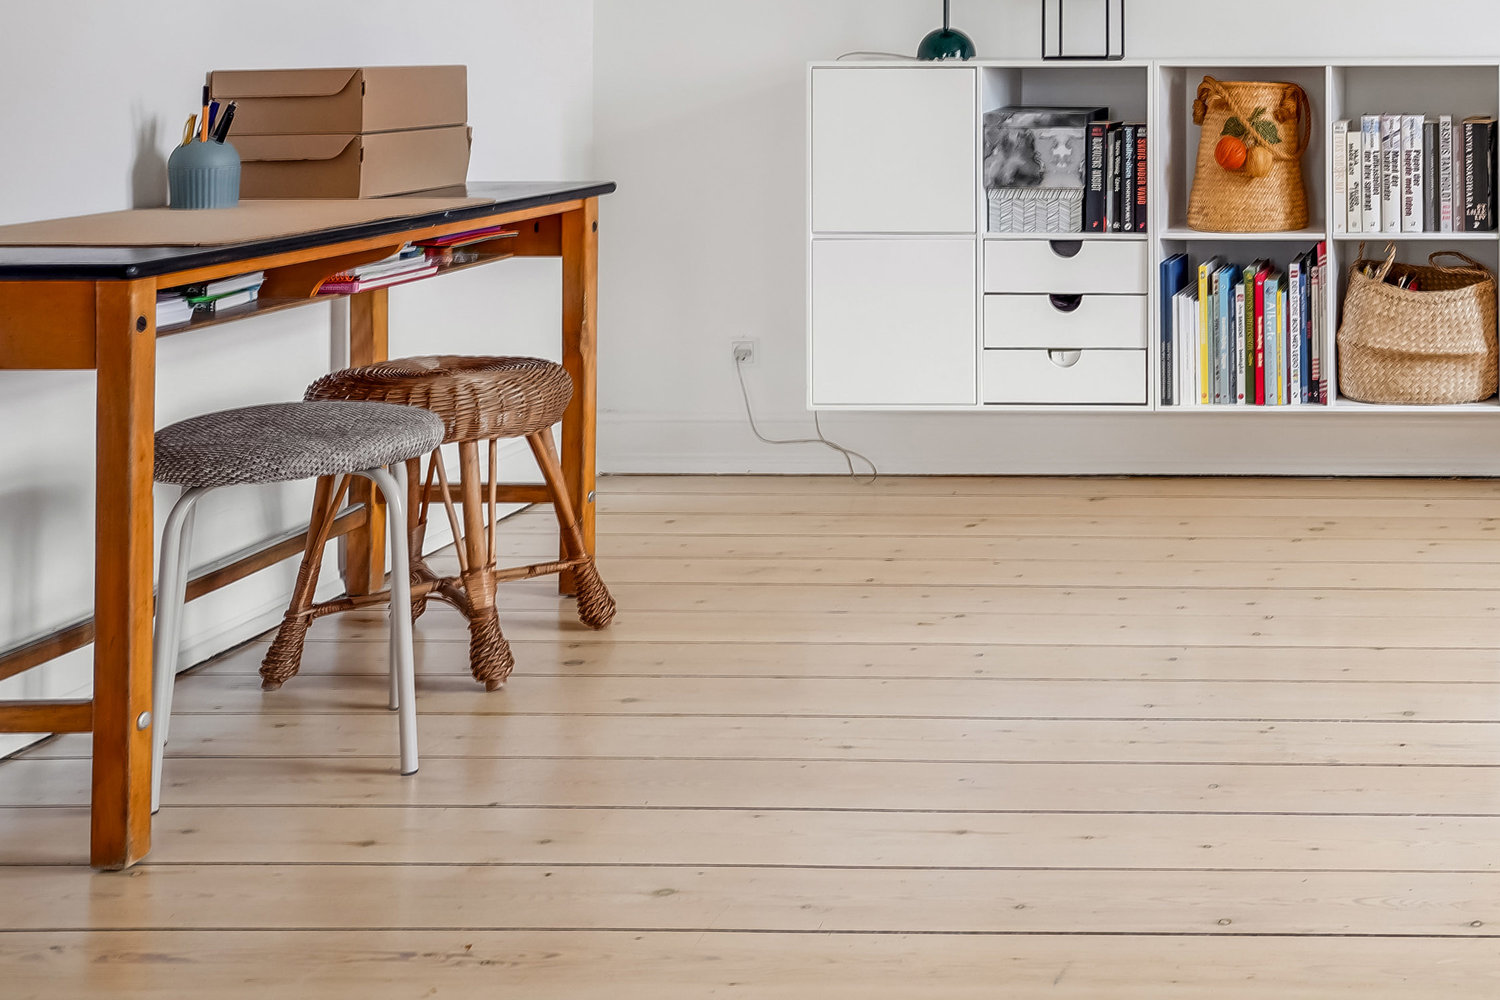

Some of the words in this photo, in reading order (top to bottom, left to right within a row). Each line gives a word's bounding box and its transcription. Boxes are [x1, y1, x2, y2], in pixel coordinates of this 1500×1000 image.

[1441, 121, 1450, 155] RASMUS
[1465, 124, 1473, 152] HANYA
[1137, 161, 1146, 185] UNDER
[1137, 186, 1146, 205] VAND
